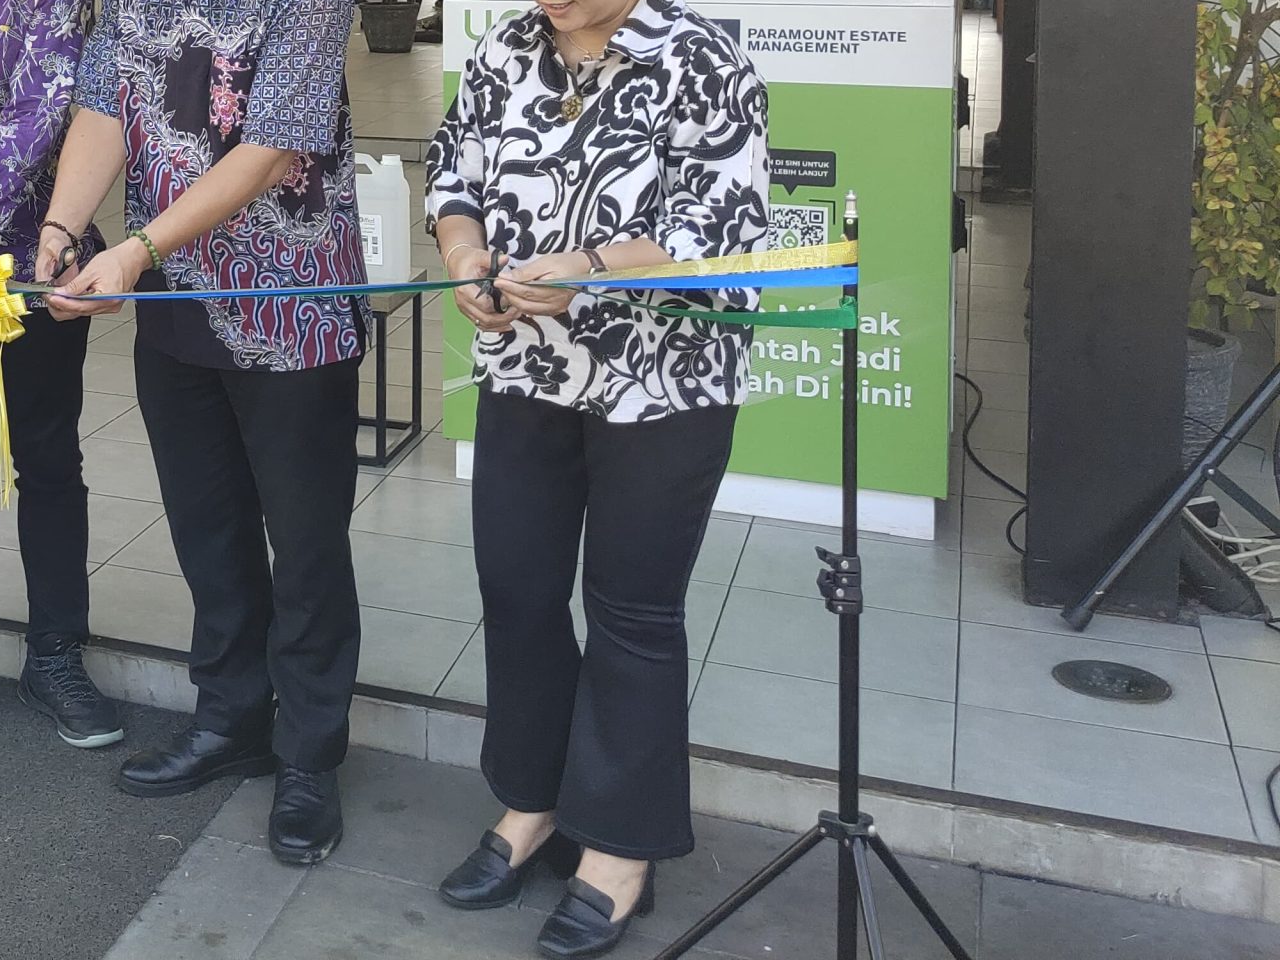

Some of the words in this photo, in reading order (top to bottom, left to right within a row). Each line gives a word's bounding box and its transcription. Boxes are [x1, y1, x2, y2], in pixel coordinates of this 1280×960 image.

[747, 28, 846, 41] PARAMOUNT
[849, 30, 907, 42] ESTATE
[747, 40, 860, 54] MANAGEMENT
[752, 339, 820, 364] ntah
[796, 374, 829, 400] Di
[840, 379, 911, 408] ini!
